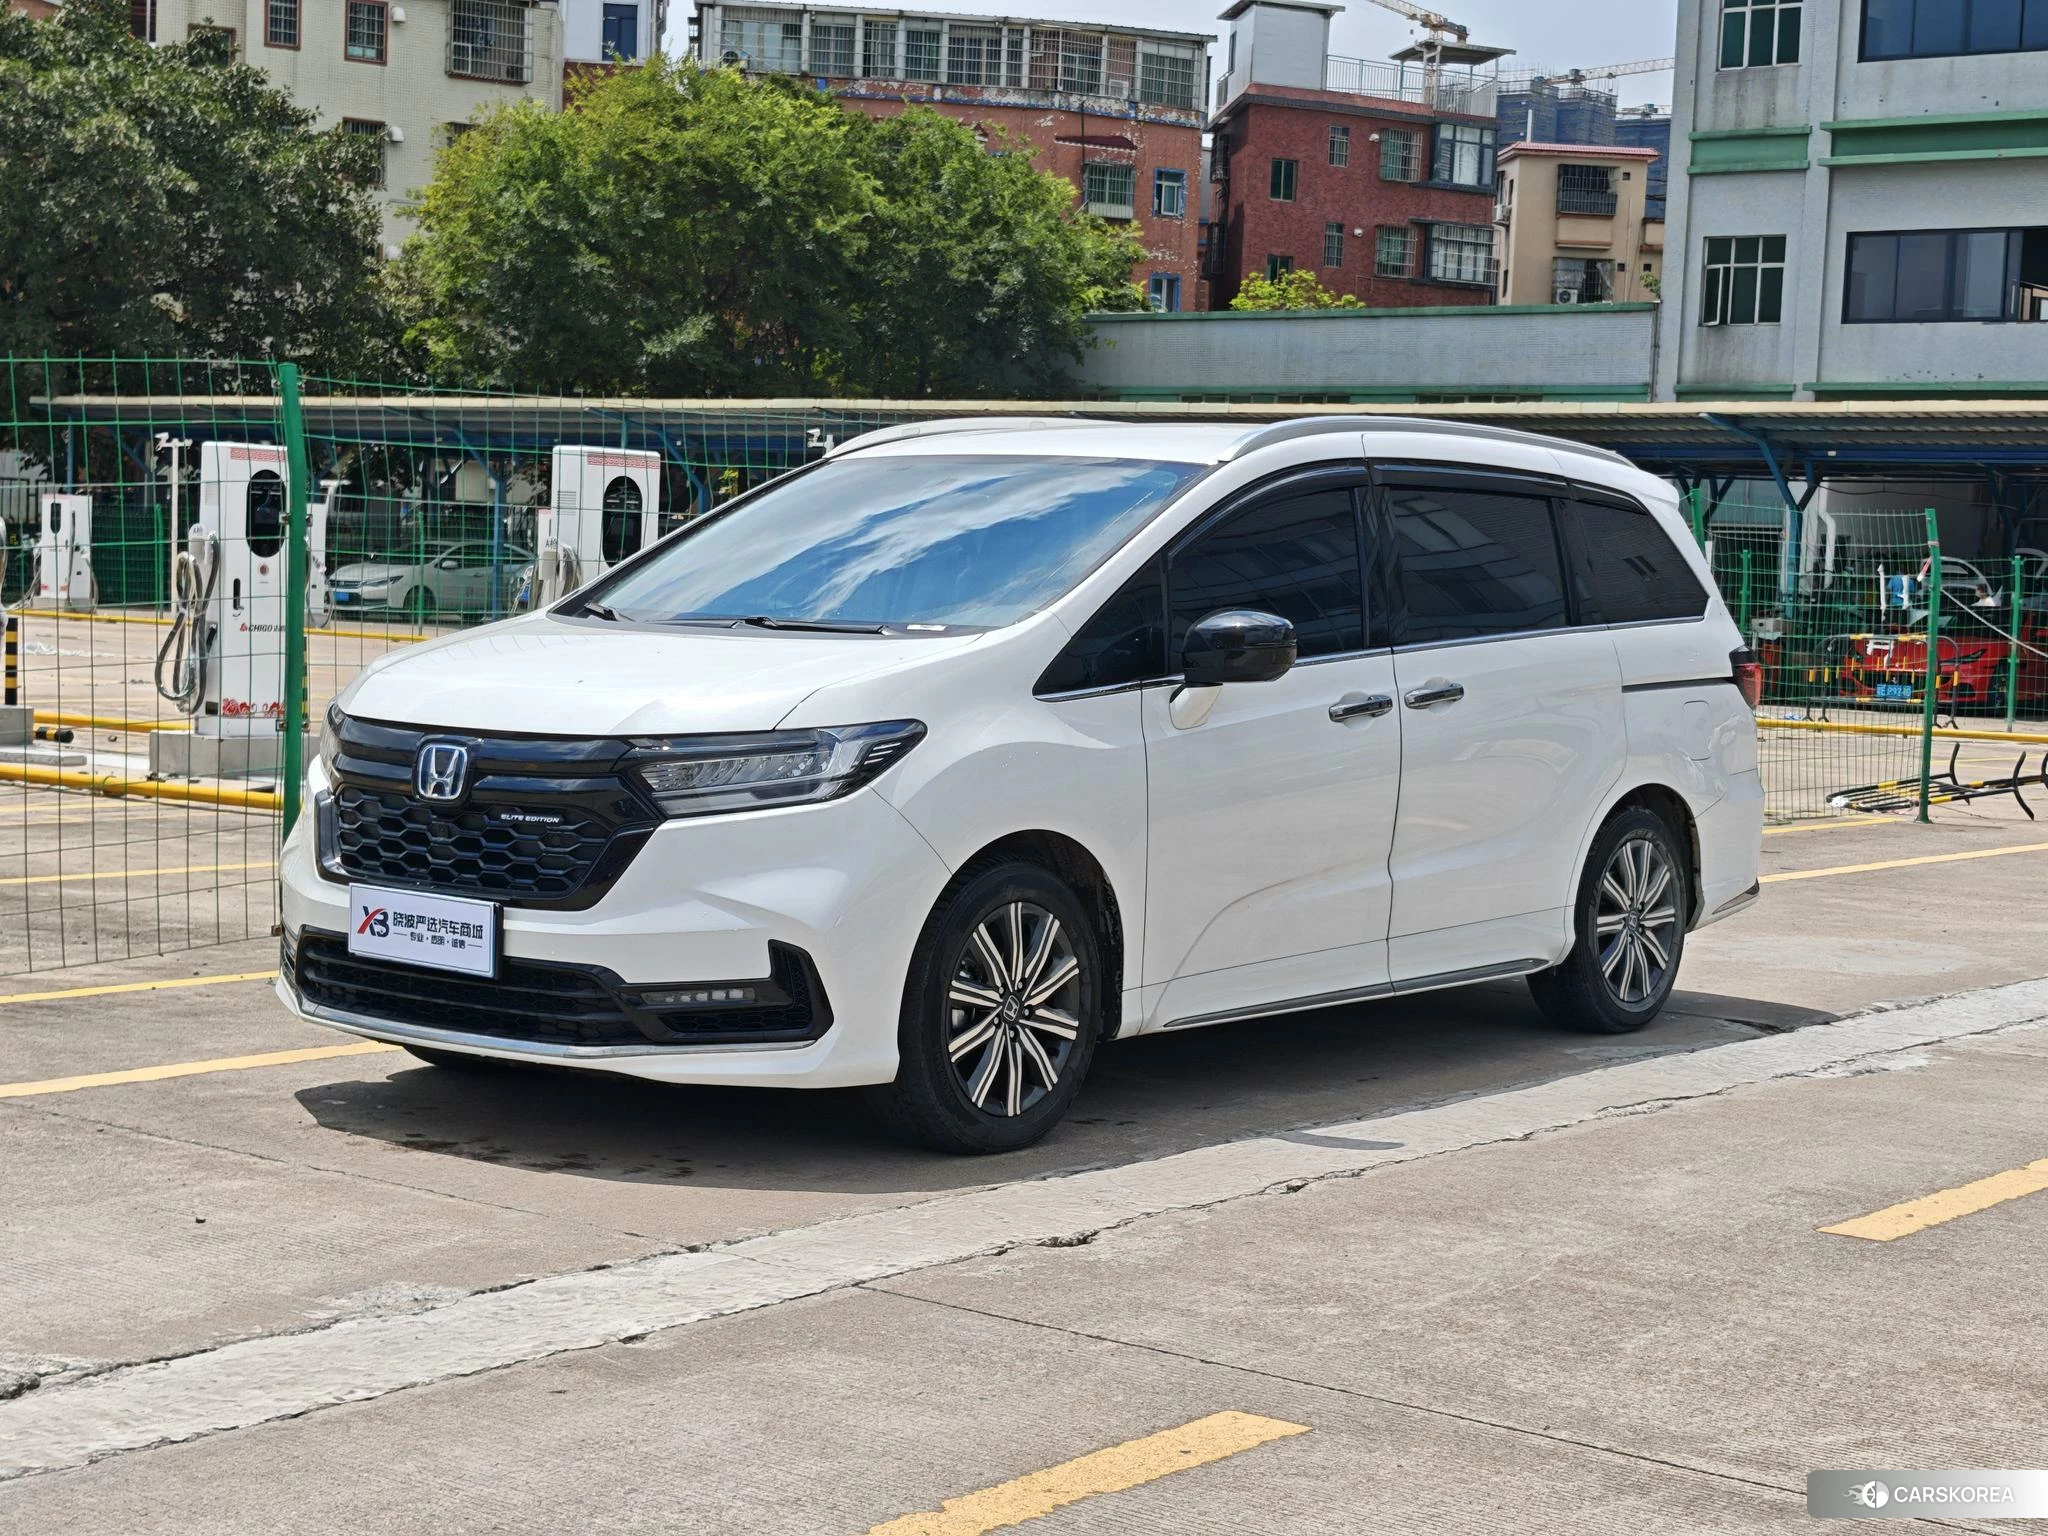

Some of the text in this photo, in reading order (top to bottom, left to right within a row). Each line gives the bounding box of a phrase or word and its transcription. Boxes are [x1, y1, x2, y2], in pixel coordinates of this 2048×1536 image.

[500, 813, 560, 824] ELITE EDITION
[392, 911, 484, 940] 晓波严选汽车商城
